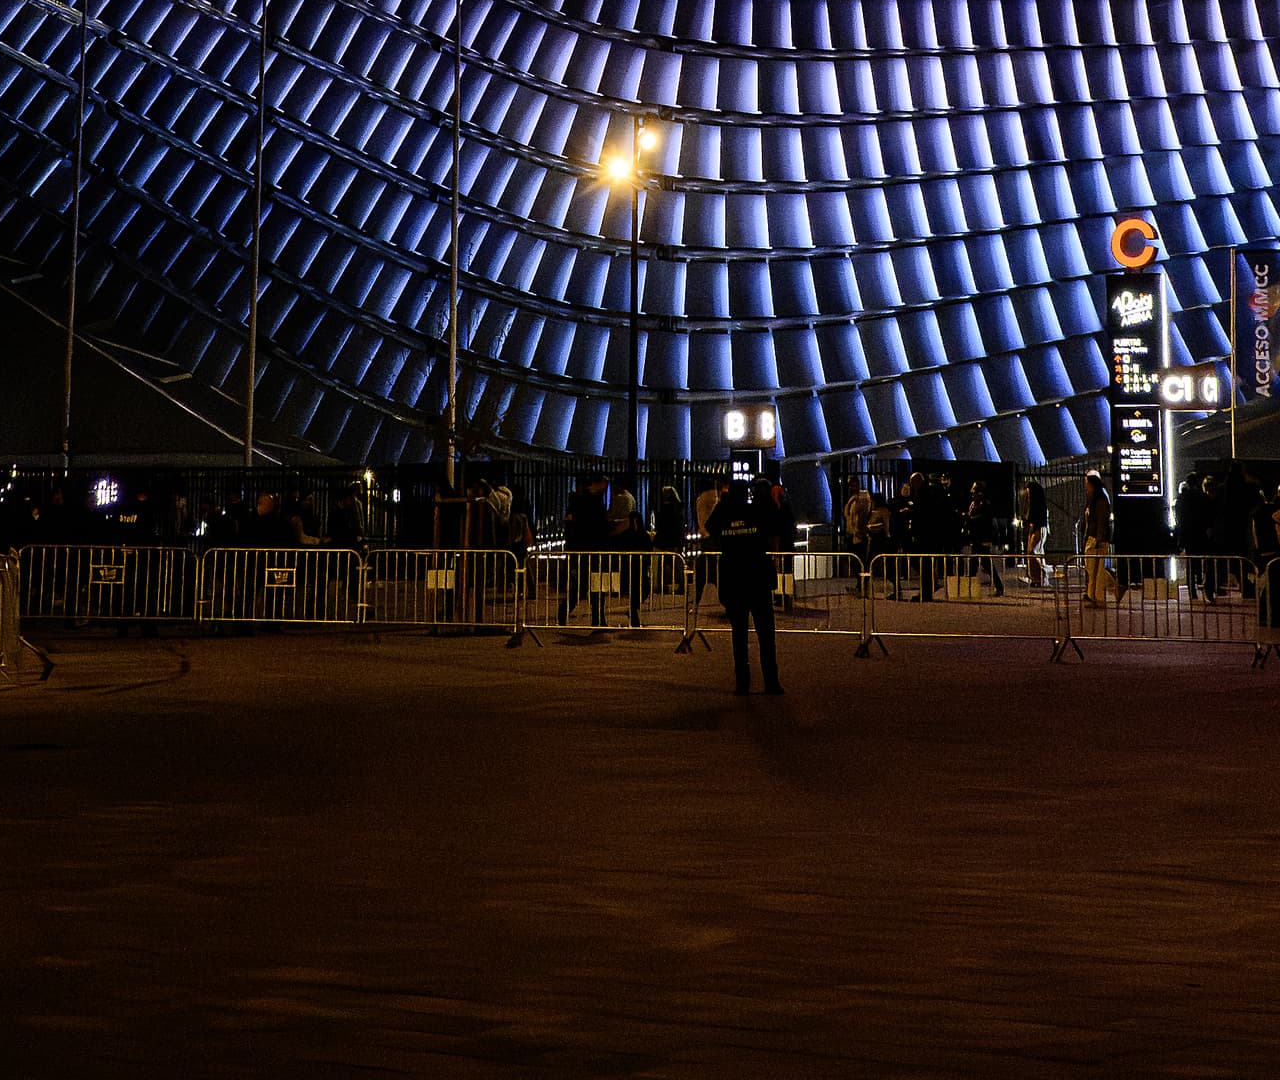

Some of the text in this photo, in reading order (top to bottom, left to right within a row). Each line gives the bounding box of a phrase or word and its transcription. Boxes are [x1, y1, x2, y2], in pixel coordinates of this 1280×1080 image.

[1111, 218, 1157, 268] C
[1121, 310, 1153, 327] ARENA
[1255, 324, 1271, 399] ACCESO
[725, 410, 775, 441] B B
